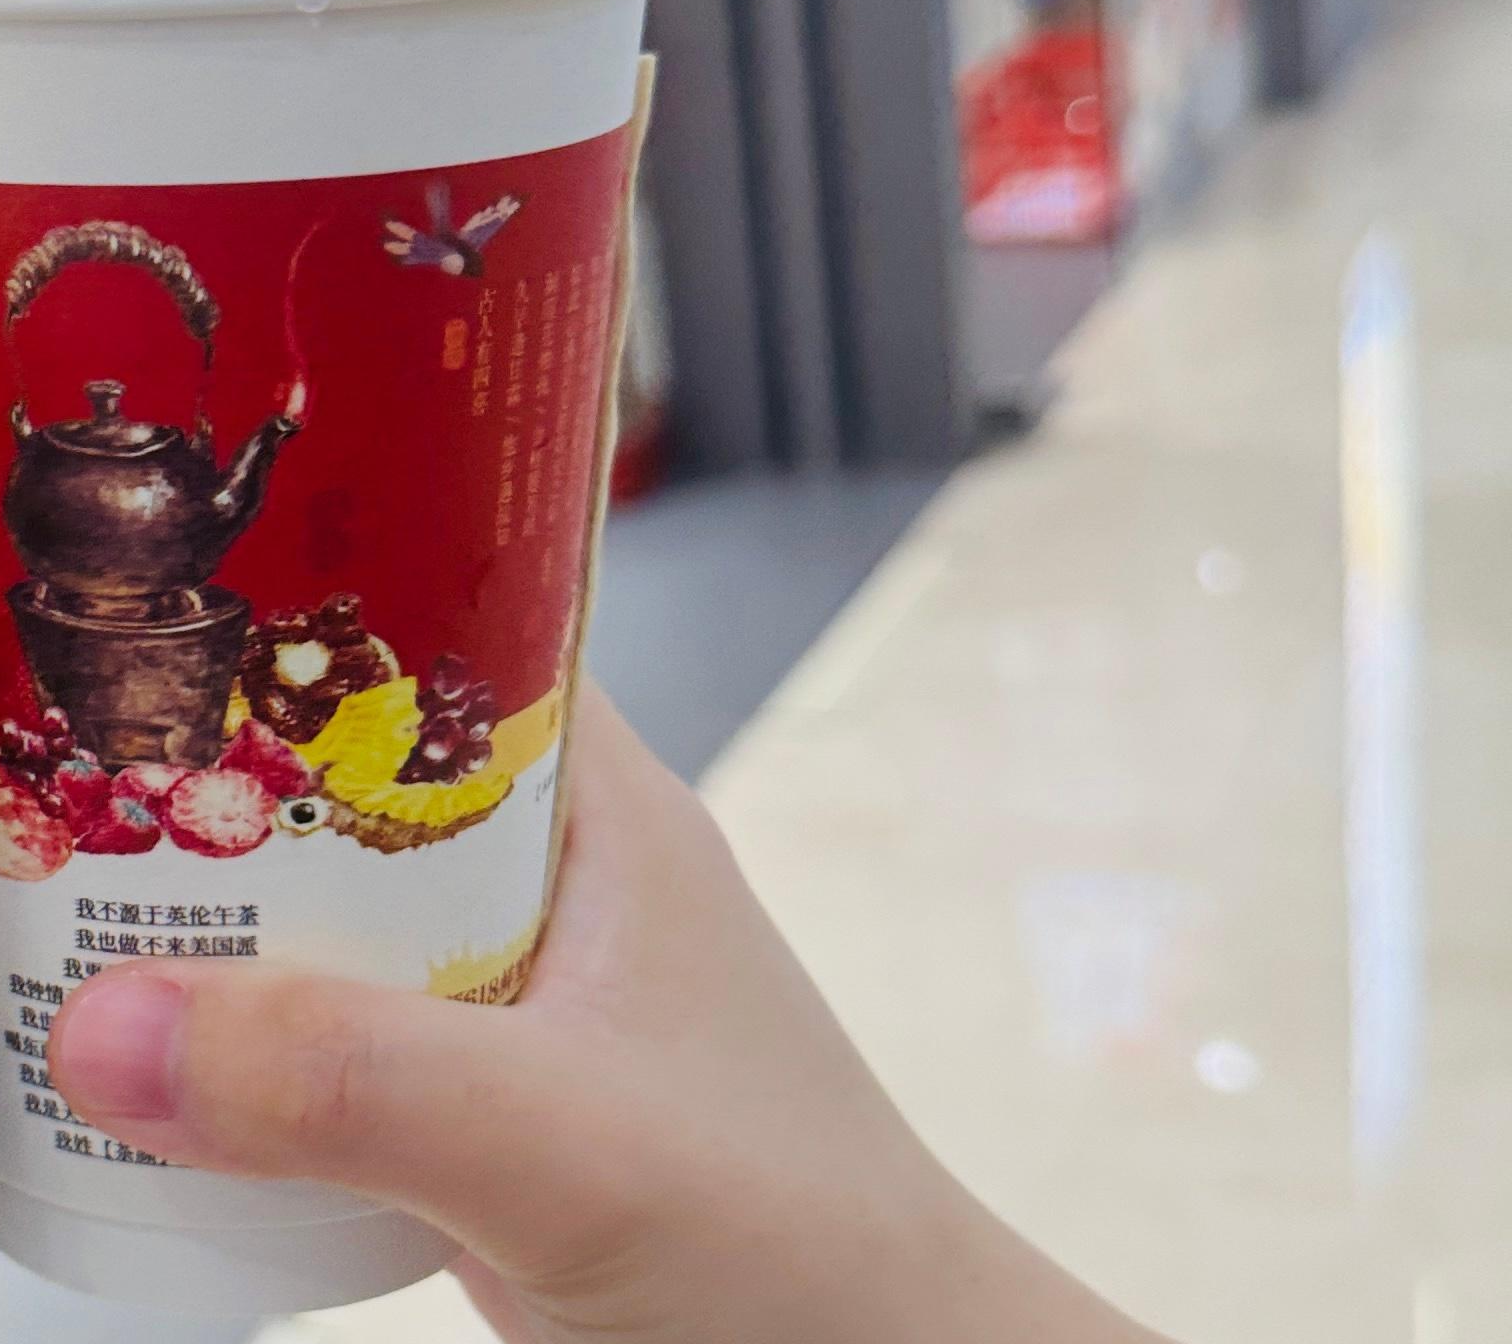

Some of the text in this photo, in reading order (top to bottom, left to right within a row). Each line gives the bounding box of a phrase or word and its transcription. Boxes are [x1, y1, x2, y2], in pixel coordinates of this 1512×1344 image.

[74, 897, 260, 926] 我不源于英伦午茶
[74, 928, 259, 956] 我也做不来美国派
